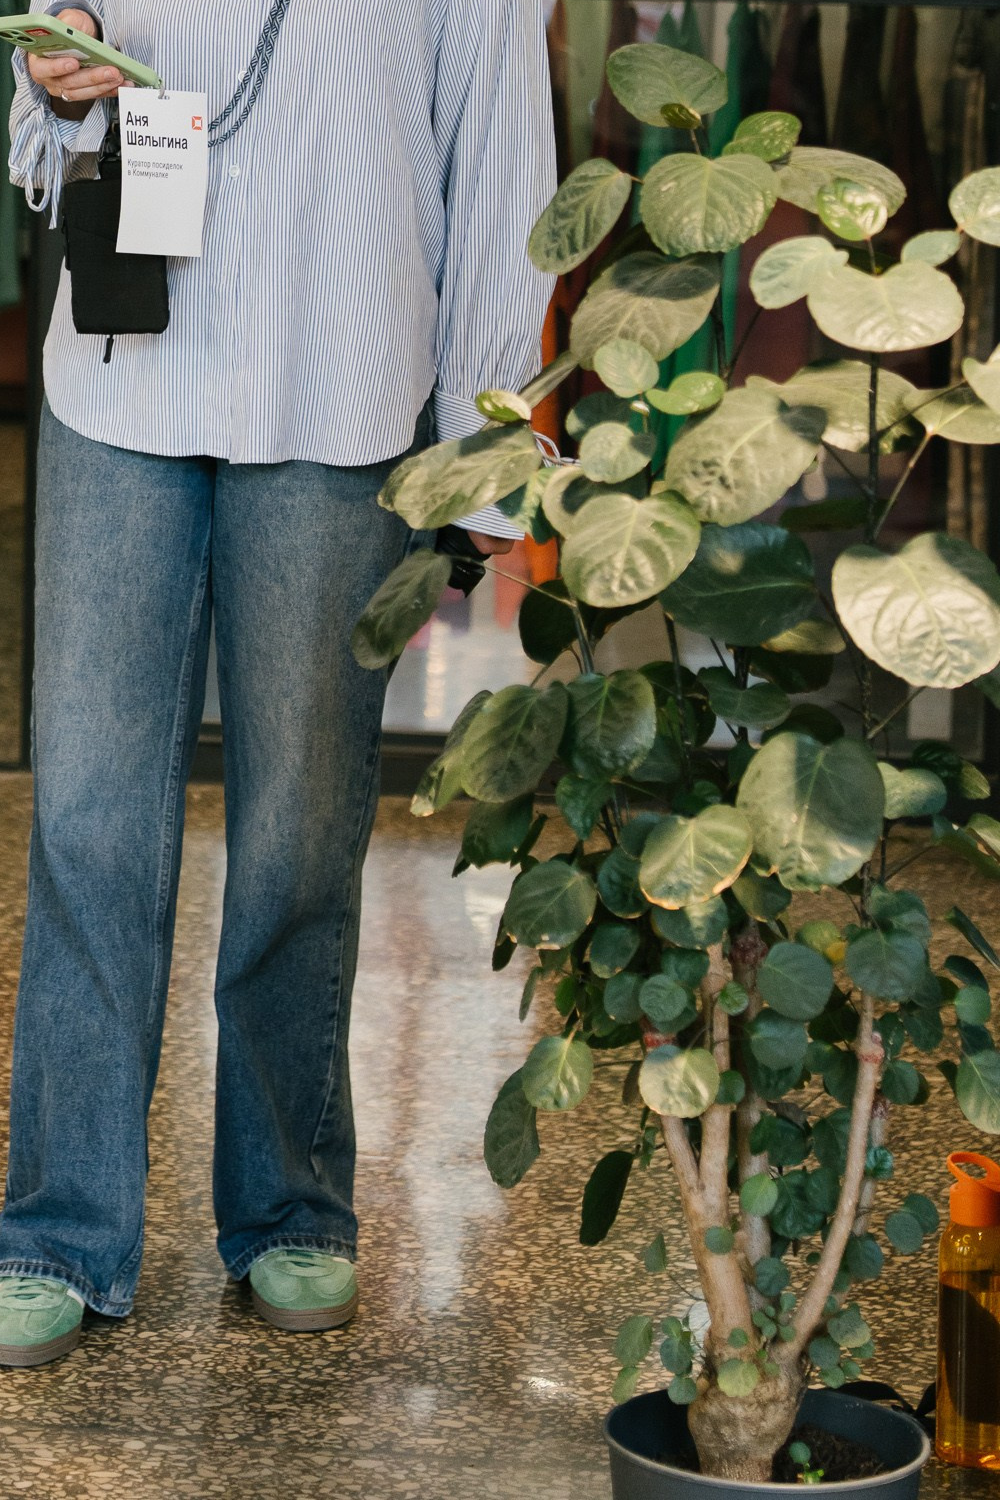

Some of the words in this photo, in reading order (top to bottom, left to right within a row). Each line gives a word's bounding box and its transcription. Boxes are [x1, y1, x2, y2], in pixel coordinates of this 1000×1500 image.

[126, 111, 149, 127] Аня
[127, 130, 188, 149] Шалыгина
[128, 159, 151, 168] Куратор
[152, 161, 183, 170] посиделок
[133, 169, 168, 179] Коммуналке
